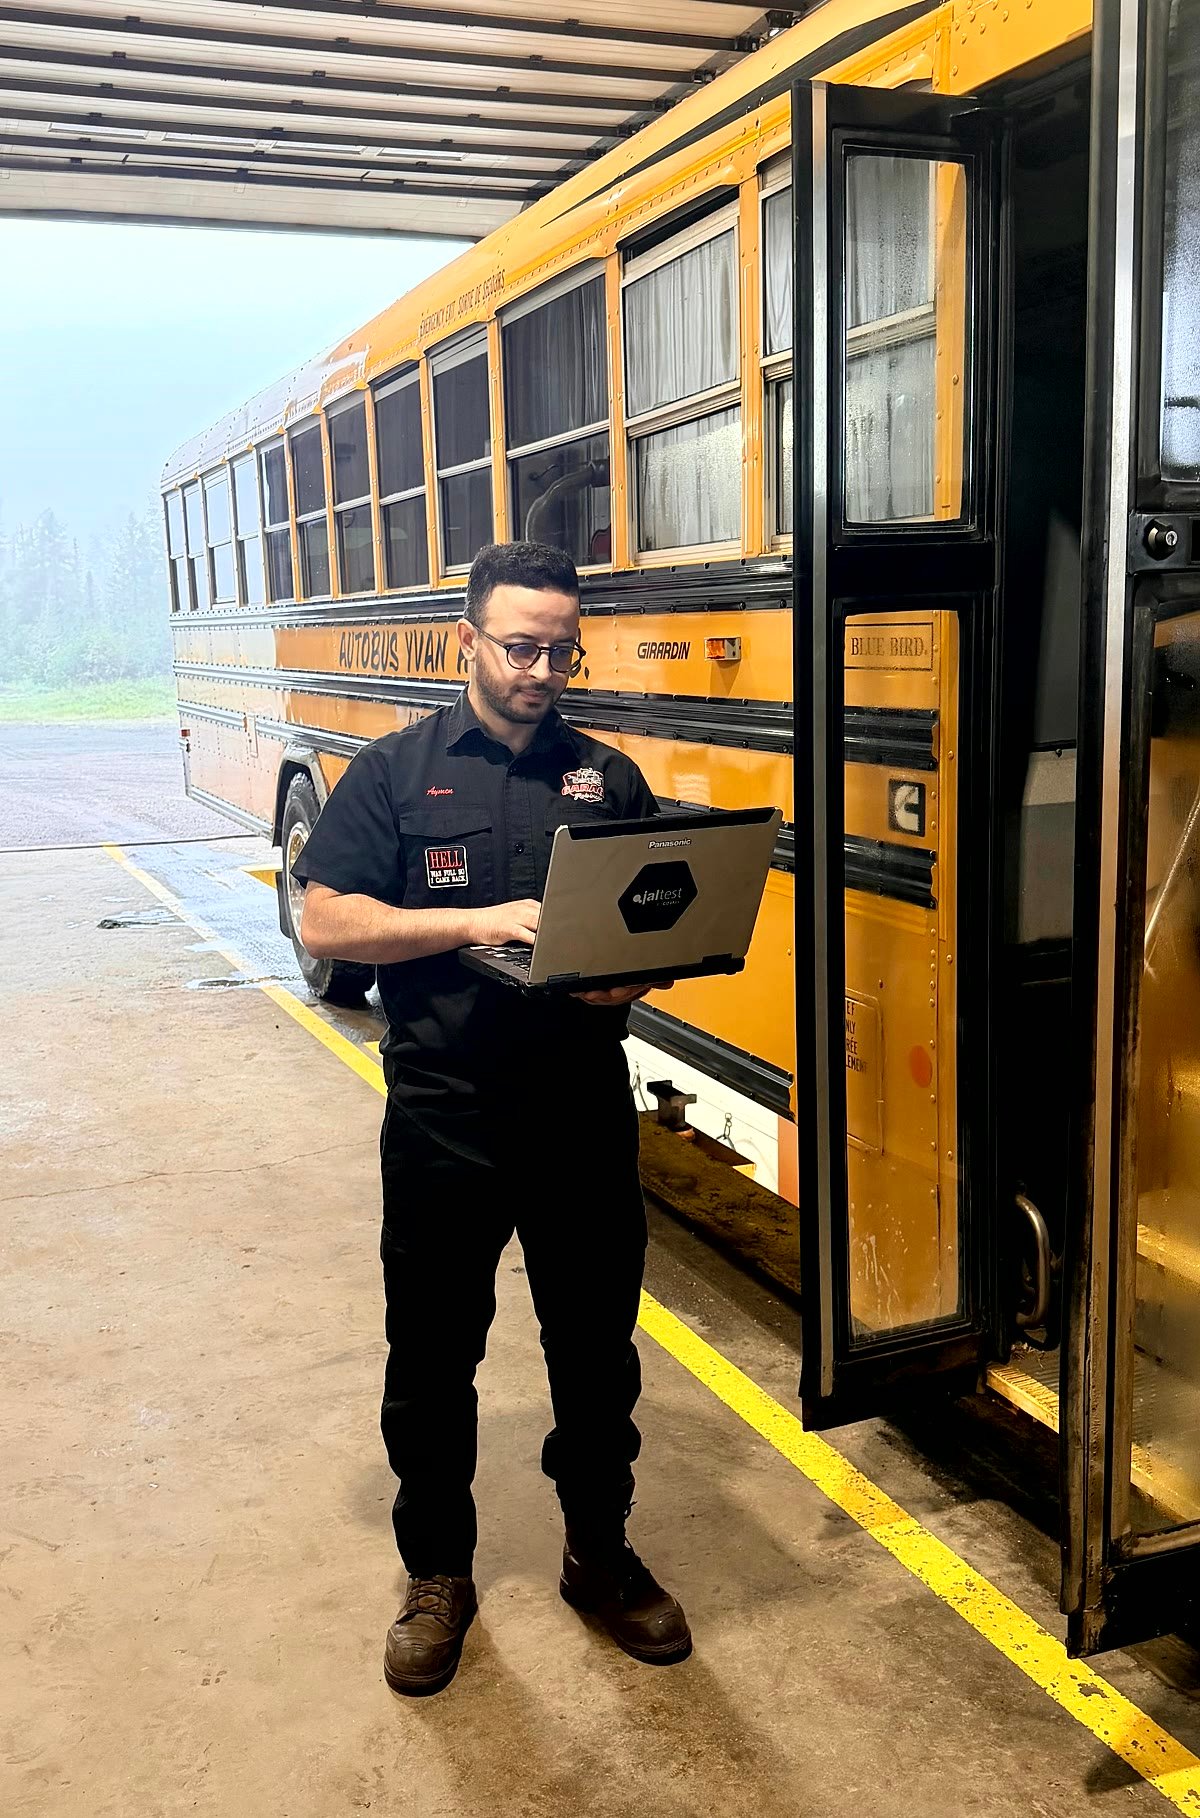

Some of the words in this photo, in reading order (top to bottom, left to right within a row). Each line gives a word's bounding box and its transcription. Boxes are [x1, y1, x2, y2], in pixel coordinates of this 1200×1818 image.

[457, 288, 476, 315] SORTIE
[482, 269, 505, 301] SECOURS
[339, 630, 399, 672] AUTOBUS
[405, 630, 449, 673] YVAN
[637, 641, 690, 660] GIRARDIN
[851, 637, 884, 656] BLUE
[648, 837, 691, 849] Panasonic
[429, 850, 463, 869] HELL
[429, 870, 442, 878] WAS
[443, 868, 457, 877] FULL
[457, 868, 466, 876] SO
[430, 877, 435, 885] I
[846, 1001, 855, 1016] EF
[845, 1020, 856, 1034] NLY
[846, 1037, 858, 1055] RÉE
